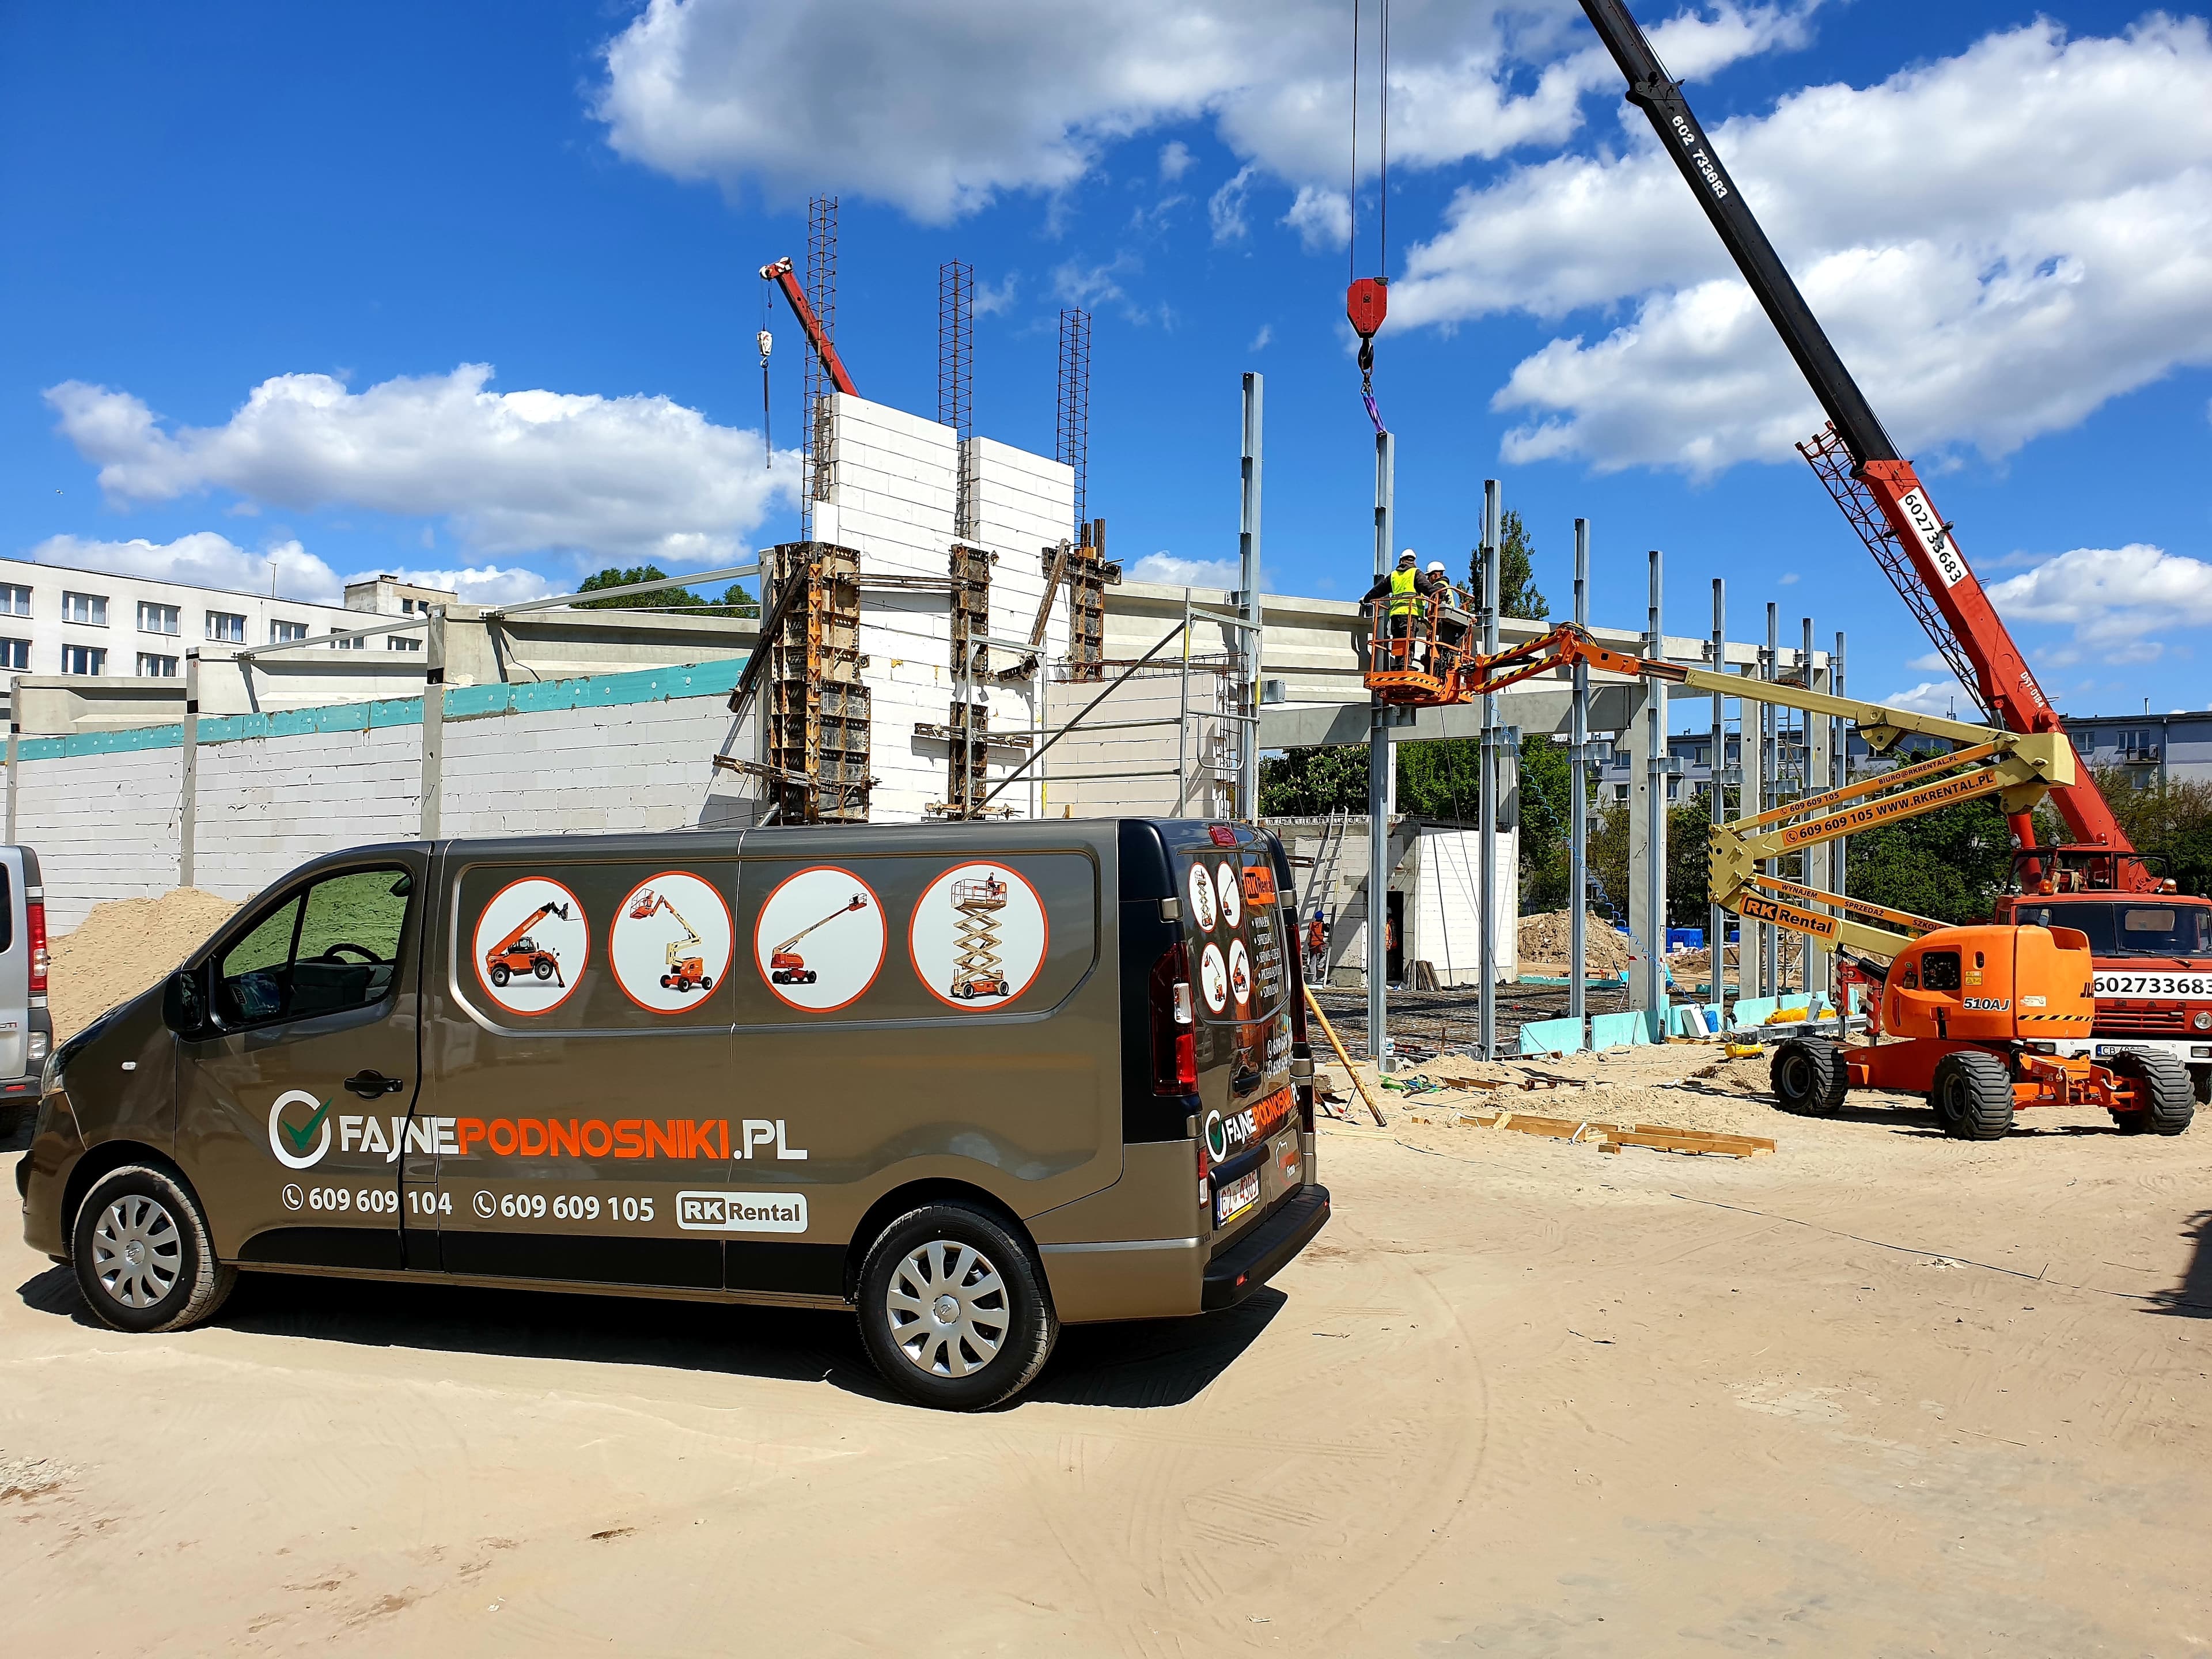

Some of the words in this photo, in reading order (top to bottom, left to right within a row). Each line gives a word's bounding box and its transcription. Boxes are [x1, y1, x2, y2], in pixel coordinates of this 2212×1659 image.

[1672, 115, 1695, 147] 602
[1692, 147, 1728, 199] 733683
[1904, 494, 1962, 582] 602733683
[1789, 802, 1805, 812] 609
[1806, 797, 1822, 807] 609
[1824, 791, 1839, 802] 105
[1878, 755, 1959, 785] BIURO@RKRENTAL.PL
[1799, 824, 1822, 838] 609
[1824, 816, 1847, 831] 609
[1850, 808, 1873, 824] 105
[1876, 774, 1994, 816] WWW.RKRENTAL.PL
[1745, 900, 1777, 921] RK
[1778, 908, 1833, 934] Rental
[1781, 883, 1819, 899] WYNAJEM
[1844, 900, 1885, 917] SPRZEDAŻ
[1963, 997, 2010, 1011] 510AJ
[1273, 1037, 1281, 1055] 609
[2103, 1047, 2116, 1055] CB
[1273, 1058, 1281, 1076] 609
[339, 1115, 808, 1163] FAJNEPODNOSNIKI.PL
[309, 1187, 350, 1211] 609
[356, 1189, 399, 1214] 609
[408, 1191, 453, 1215] 104
[501, 1194, 547, 1218] 609
[553, 1195, 600, 1220] 609
[608, 1196, 655, 1222] 105
[684, 1200, 724, 1221] RK
[729, 1202, 800, 1222] Rental
